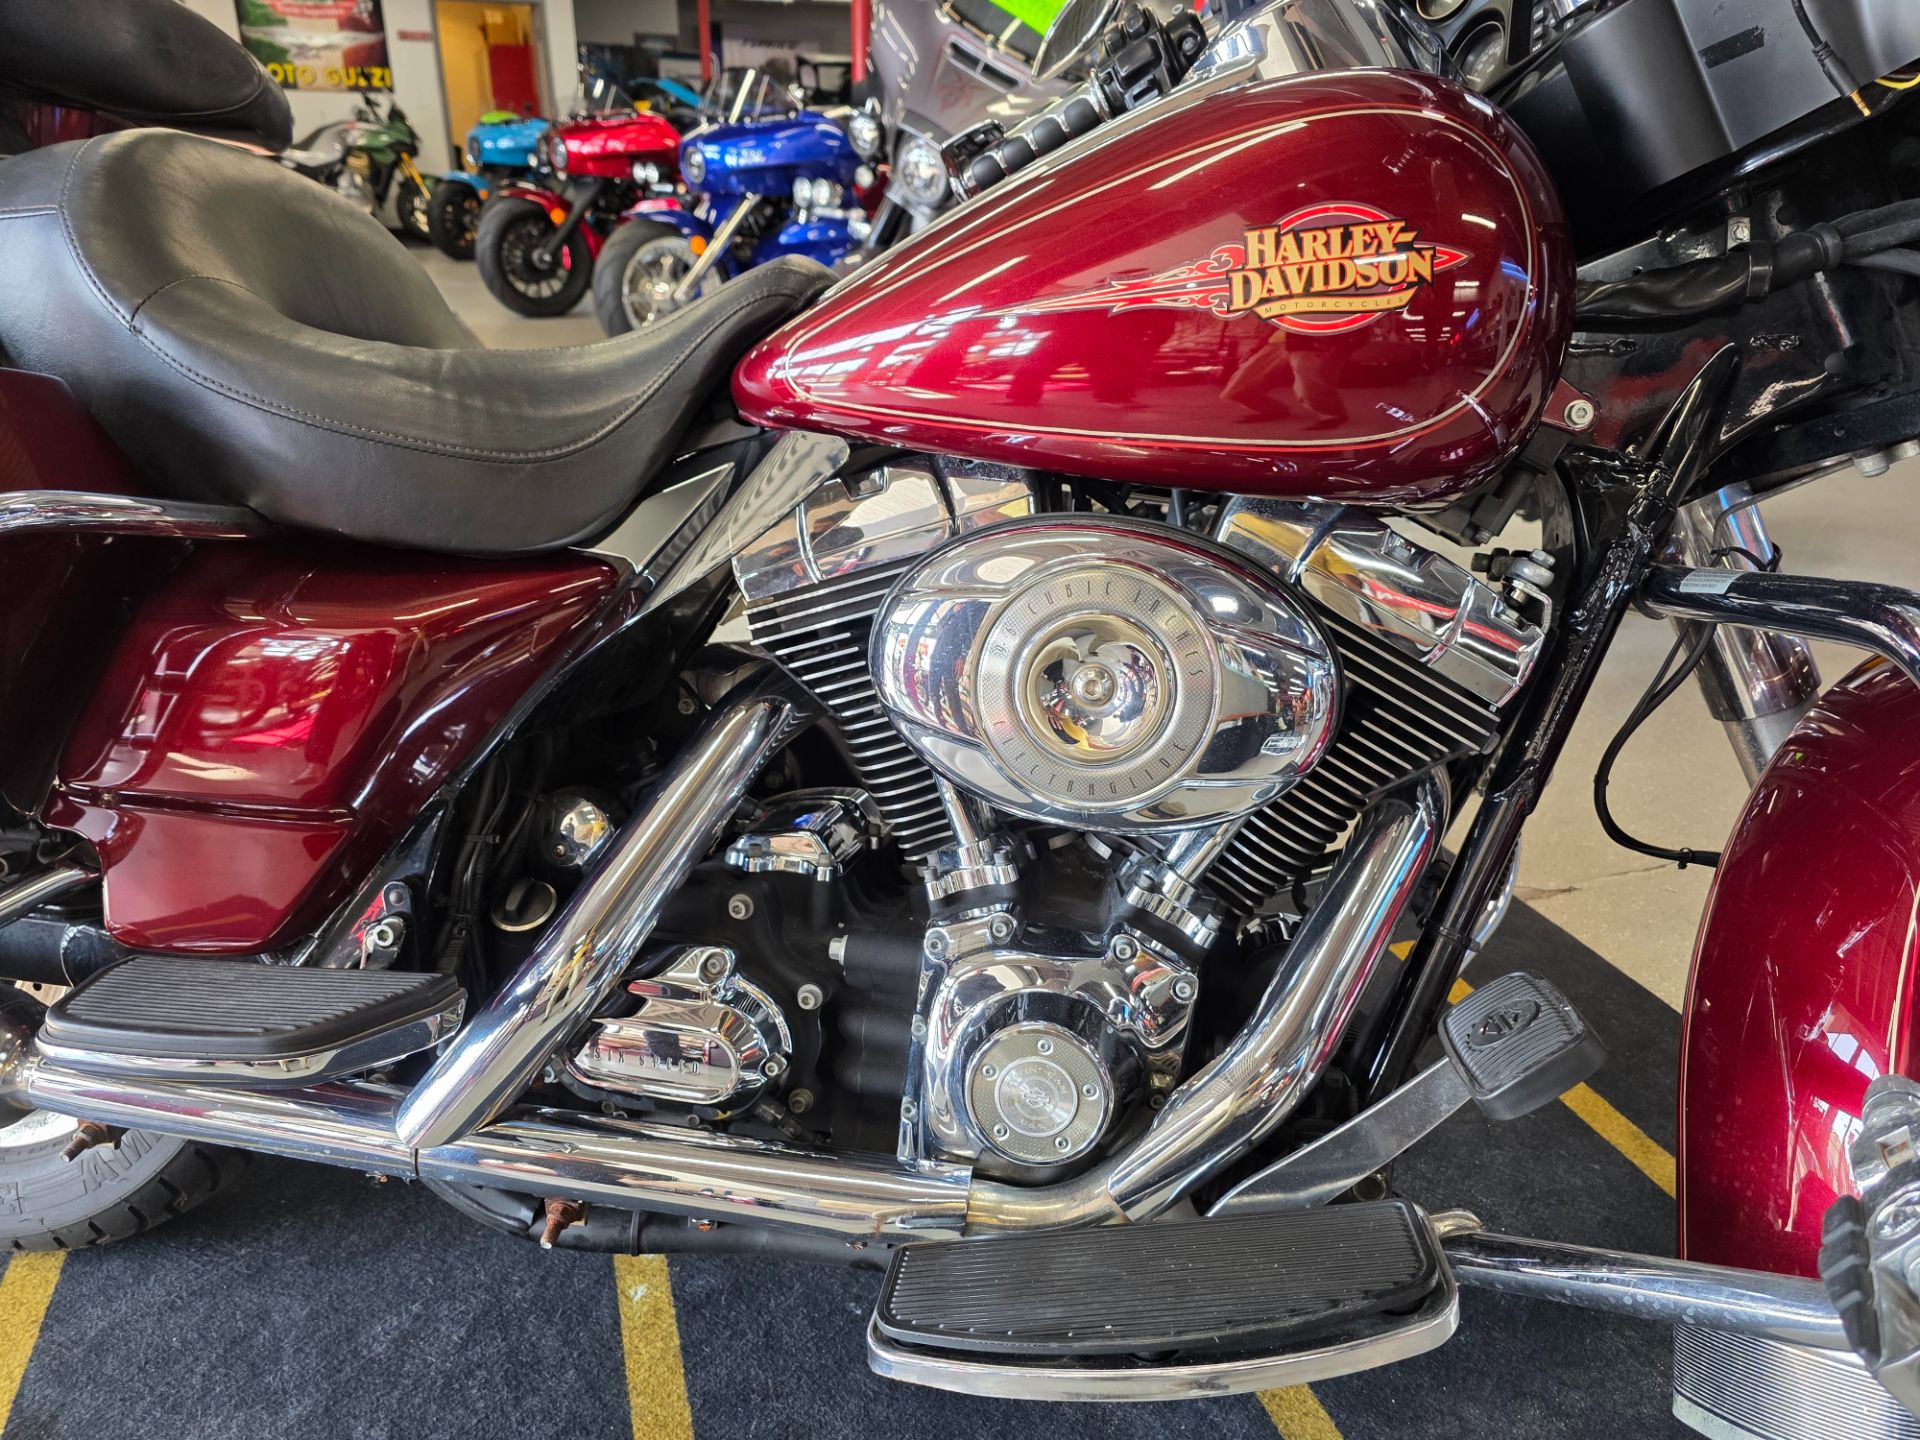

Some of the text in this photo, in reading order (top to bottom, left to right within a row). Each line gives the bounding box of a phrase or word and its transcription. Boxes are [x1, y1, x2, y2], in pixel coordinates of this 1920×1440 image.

[266, 62, 316, 86] OTO
[1243, 219, 1418, 270] HARLEY-
[1228, 249, 1434, 311] DAVIDSON
[1264, 296, 1405, 314] MOTORCYCLES
[1027, 581, 1112, 615] CUBIC
[1134, 589, 1204, 677] INCHES
[593, 1047, 700, 1075] SIX SPEED
